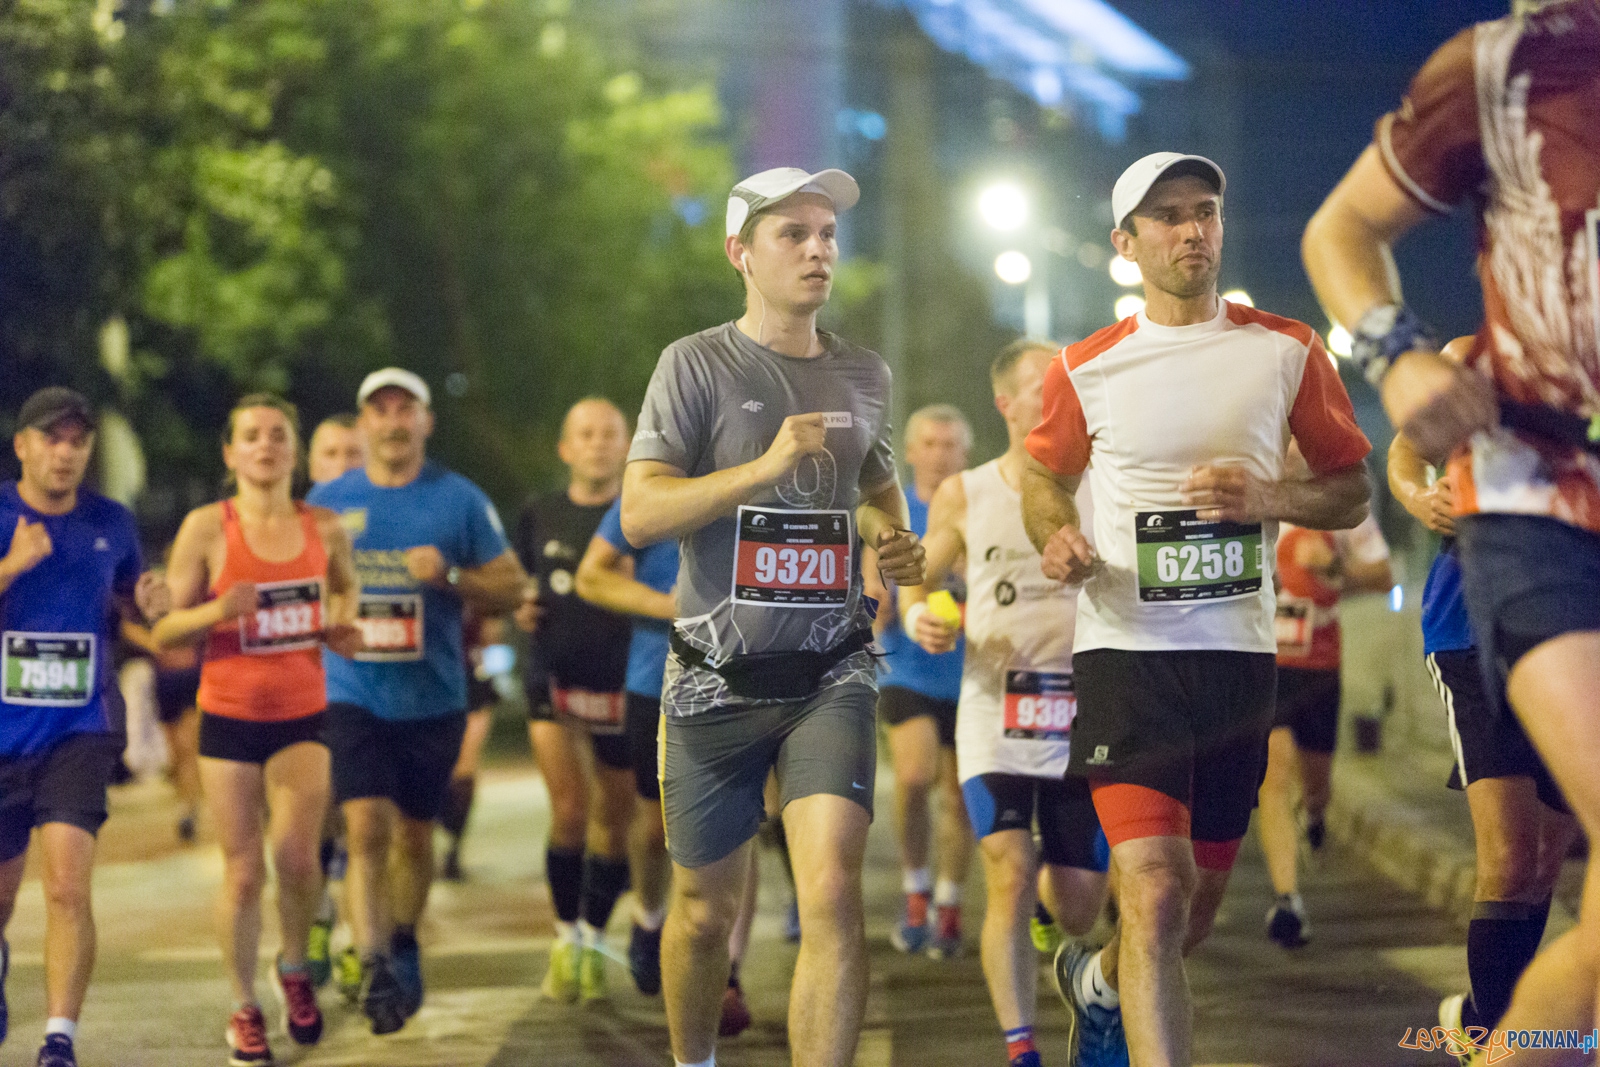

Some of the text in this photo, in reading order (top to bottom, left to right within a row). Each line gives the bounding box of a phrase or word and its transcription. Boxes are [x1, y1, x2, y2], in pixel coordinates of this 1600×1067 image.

[741, 400, 764, 412] 4F
[831, 416, 848, 424] PKO
[755, 546, 836, 585] 9320
[1156, 541, 1244, 583] 6258
[19, 660, 78, 690] 7594
